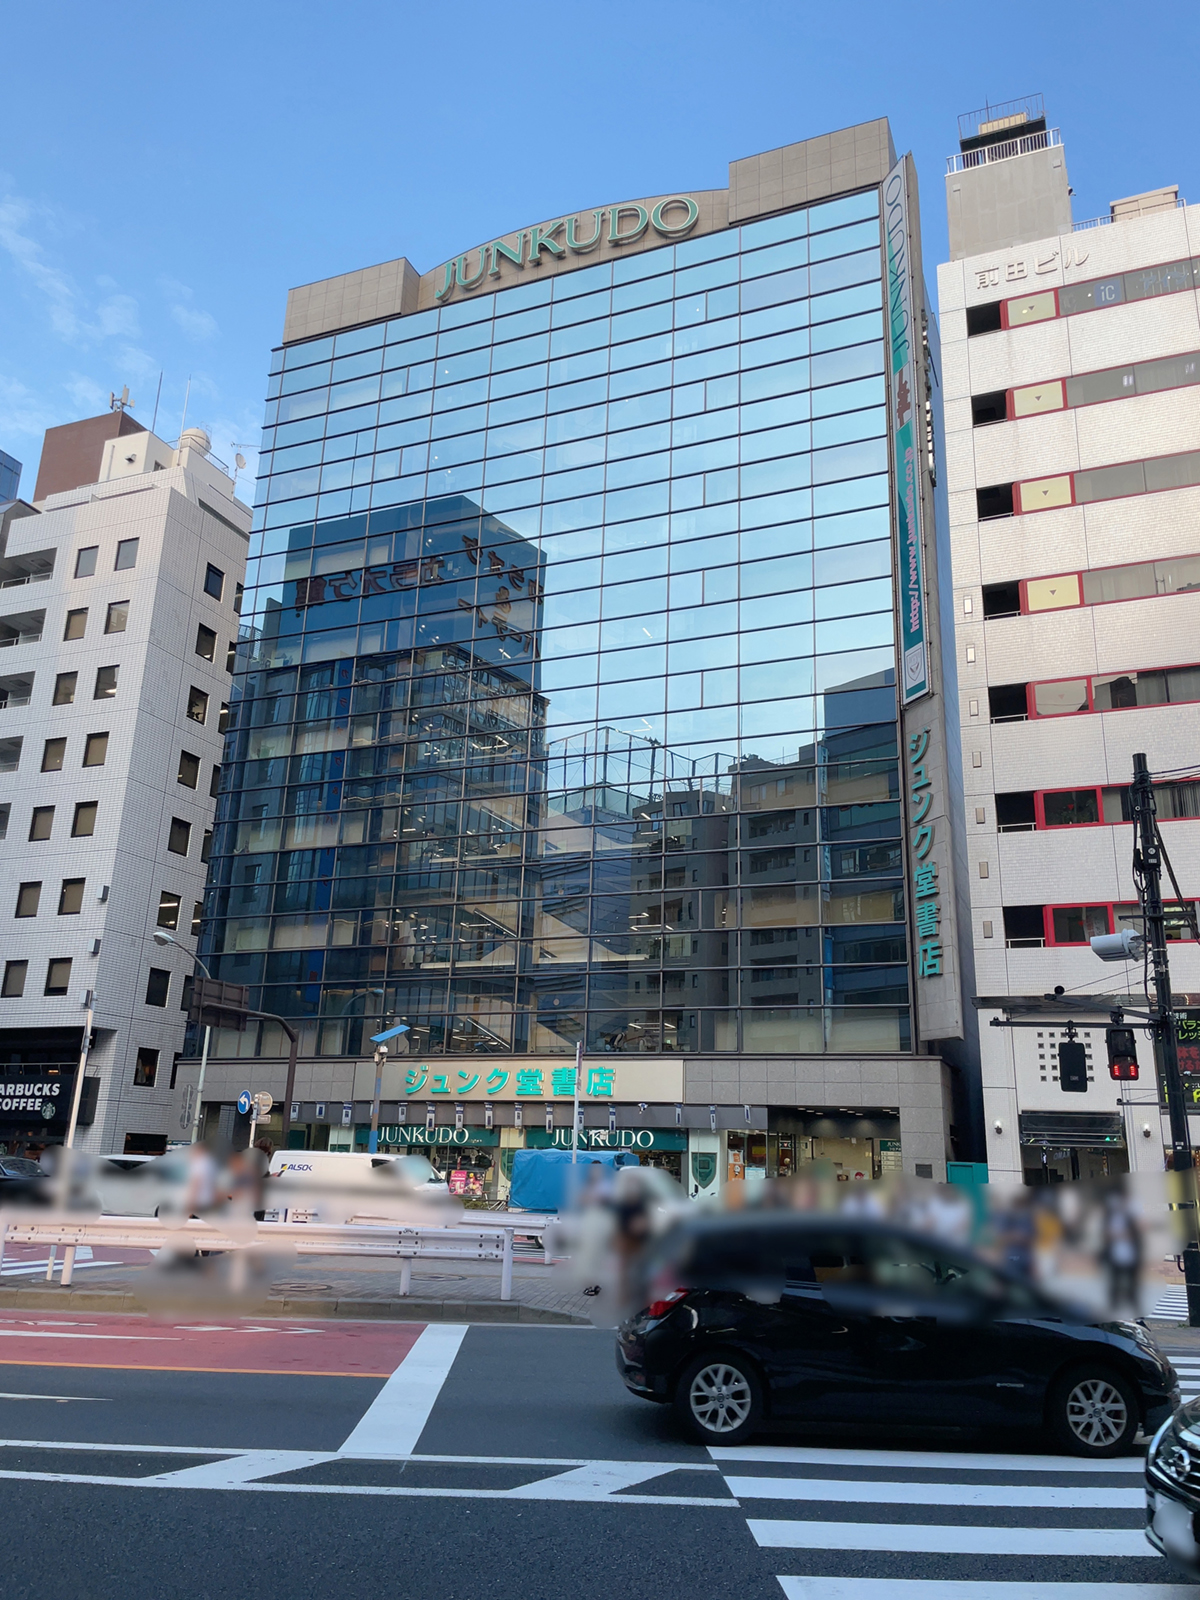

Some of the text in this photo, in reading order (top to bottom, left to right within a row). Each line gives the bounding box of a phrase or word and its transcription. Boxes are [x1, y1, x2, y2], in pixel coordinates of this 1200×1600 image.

[435, 196, 699, 300] JUNKUDO
[885, 174, 910, 352] JUNKUDO
[974, 246, 1090, 289] 前田ビル
[908, 727, 942, 977] ジュンク堂書店
[404, 1065, 616, 1097] ジュンク堂書店
[0, 1098, 43, 1111] OFFEE
[377, 1126, 470, 1144] JUNKUDO
